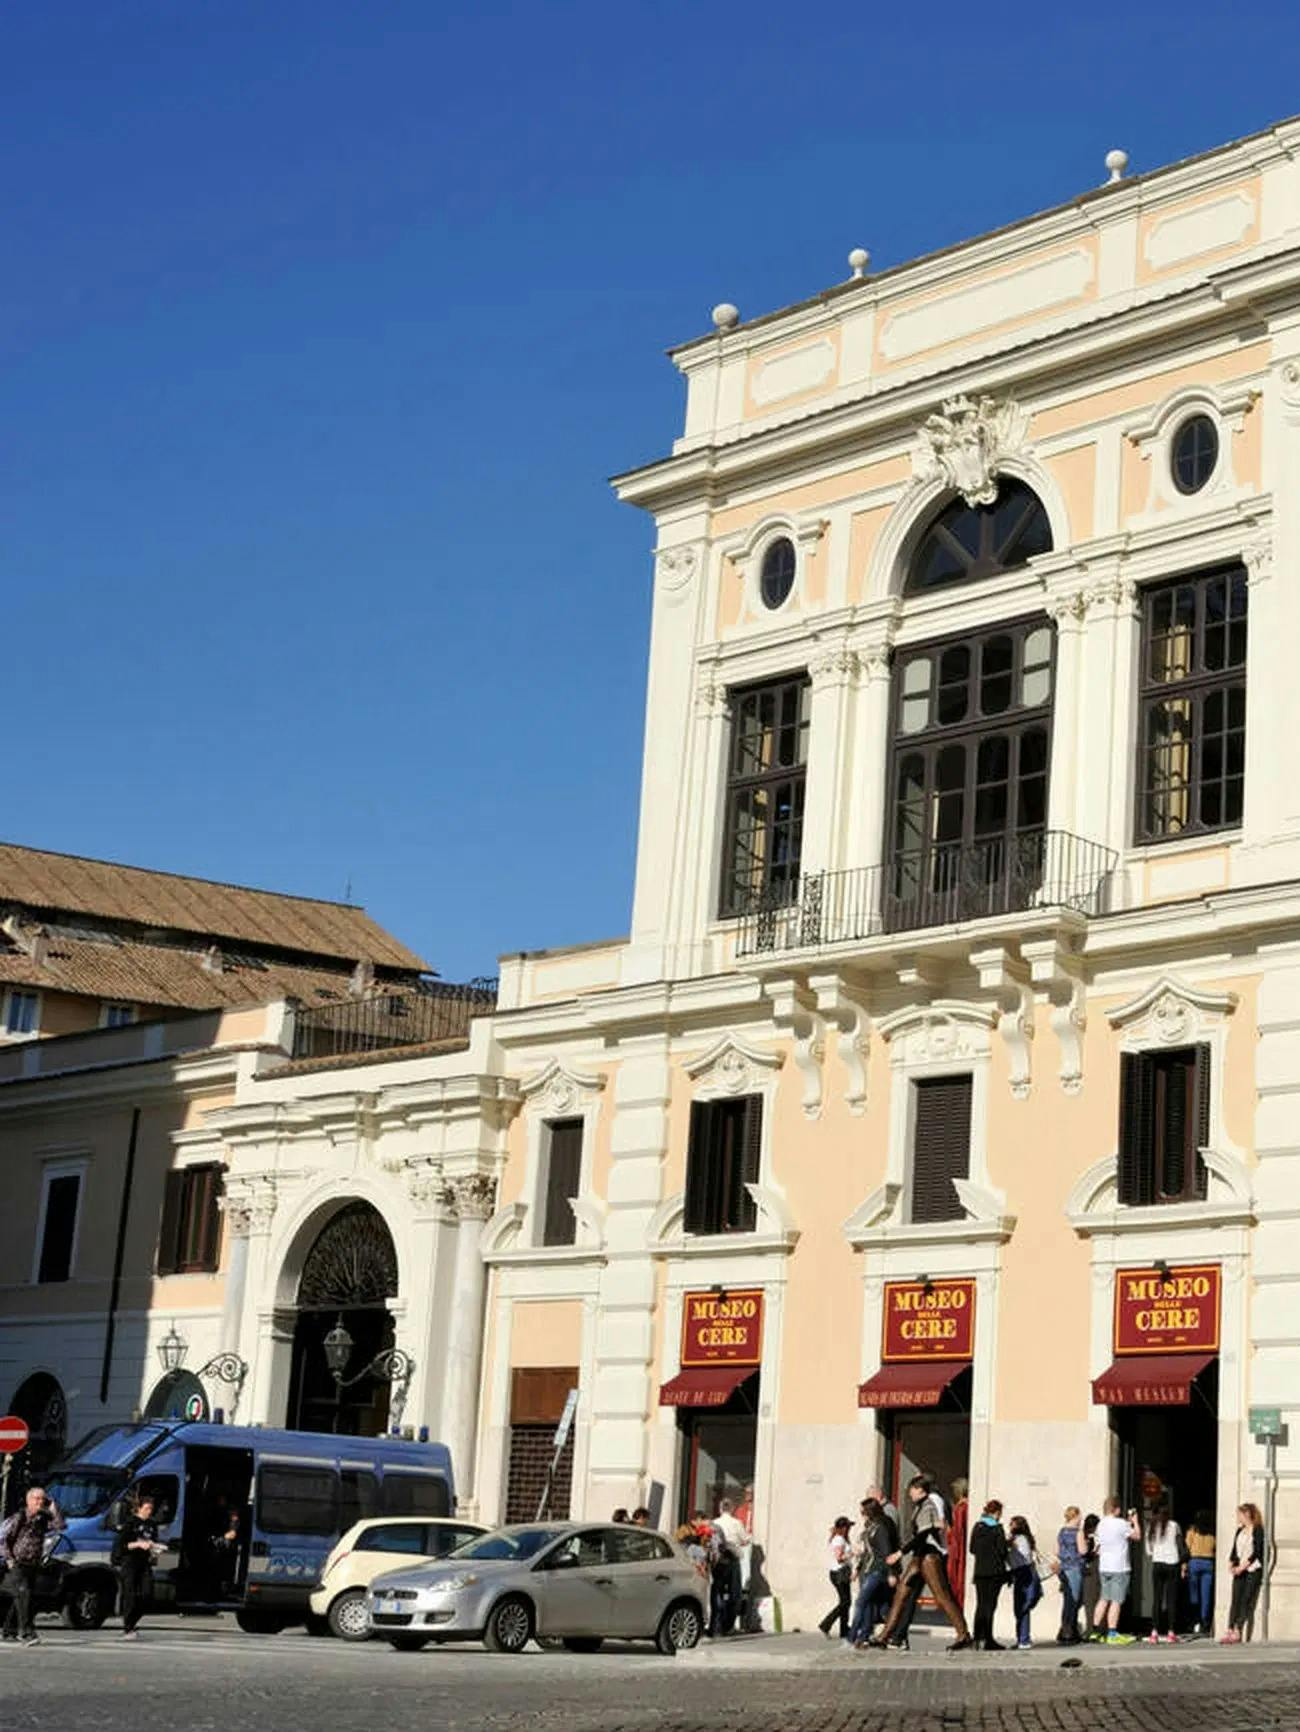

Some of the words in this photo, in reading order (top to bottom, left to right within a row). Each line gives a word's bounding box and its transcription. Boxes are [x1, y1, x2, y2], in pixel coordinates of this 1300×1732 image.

[1127, 1277, 1210, 1301] MUSEO
[692, 1299, 756, 1320] MUSEO
[895, 1290, 966, 1311] MUSEO
[901, 1319, 957, 1339] CERE
[1135, 1308, 1199, 1331] CERE
[698, 1327, 748, 1346] CERE
